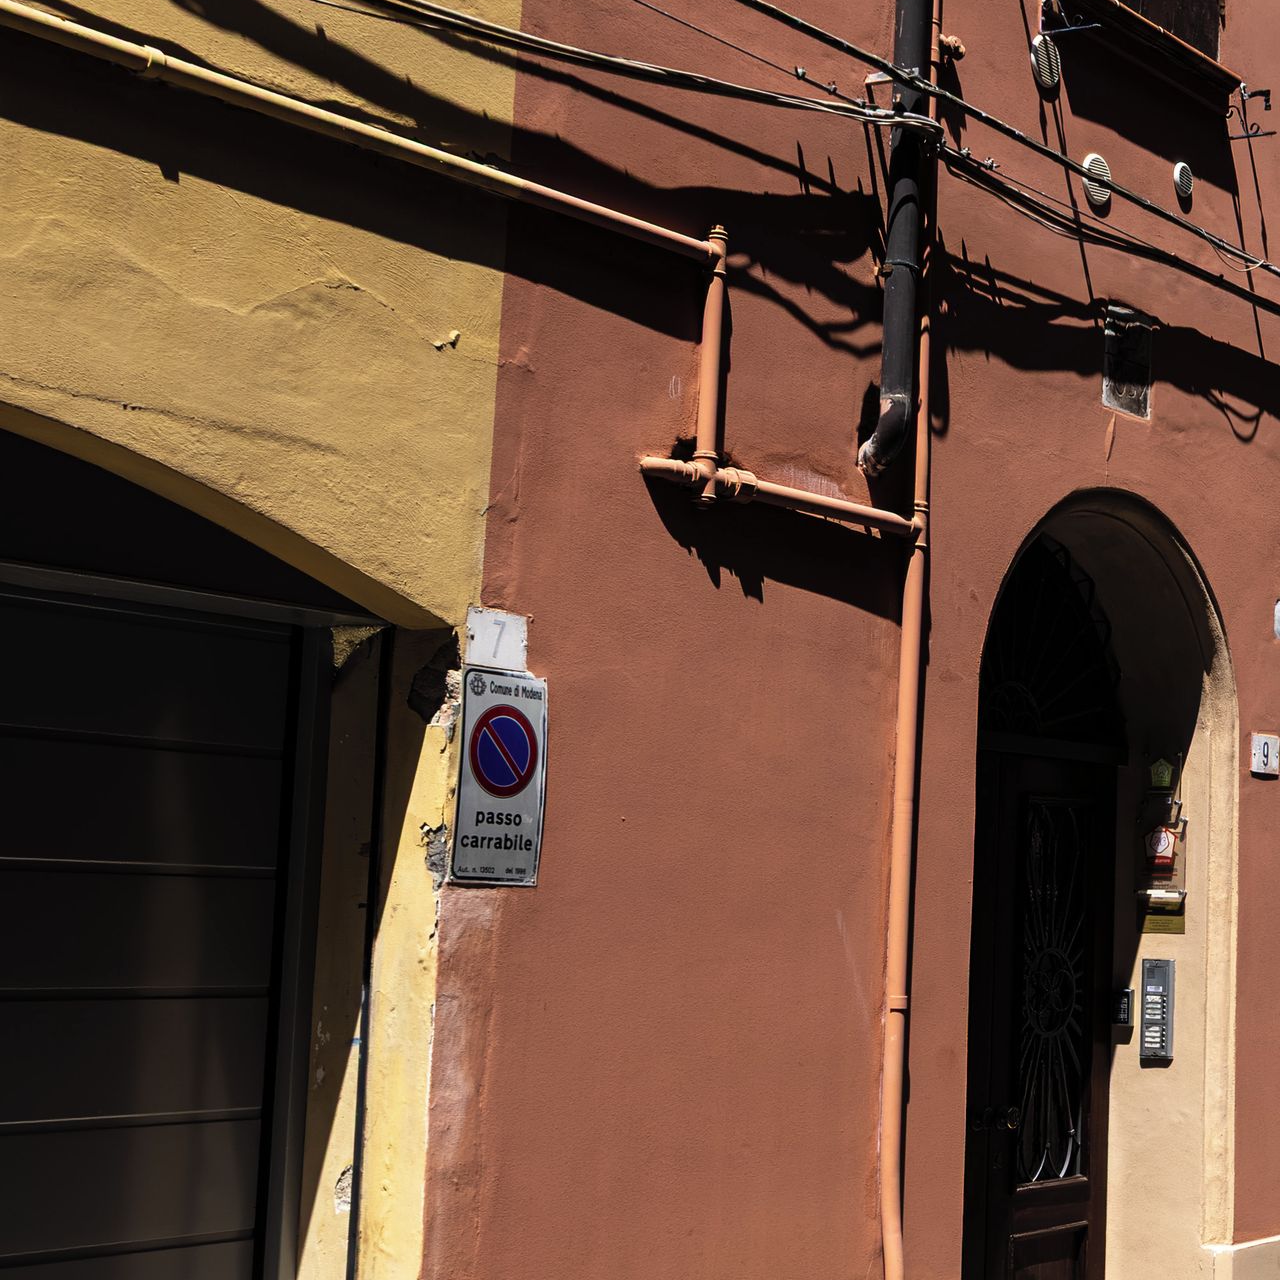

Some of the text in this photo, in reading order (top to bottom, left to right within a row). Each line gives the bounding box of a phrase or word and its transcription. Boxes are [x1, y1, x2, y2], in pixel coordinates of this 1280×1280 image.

[493, 619, 506, 659] 7
[489, 681, 543, 700] Comune di Modena
[1262, 740, 1270, 767] 9
[475, 810, 522, 827] passo
[460, 833, 533, 851] carrabile
